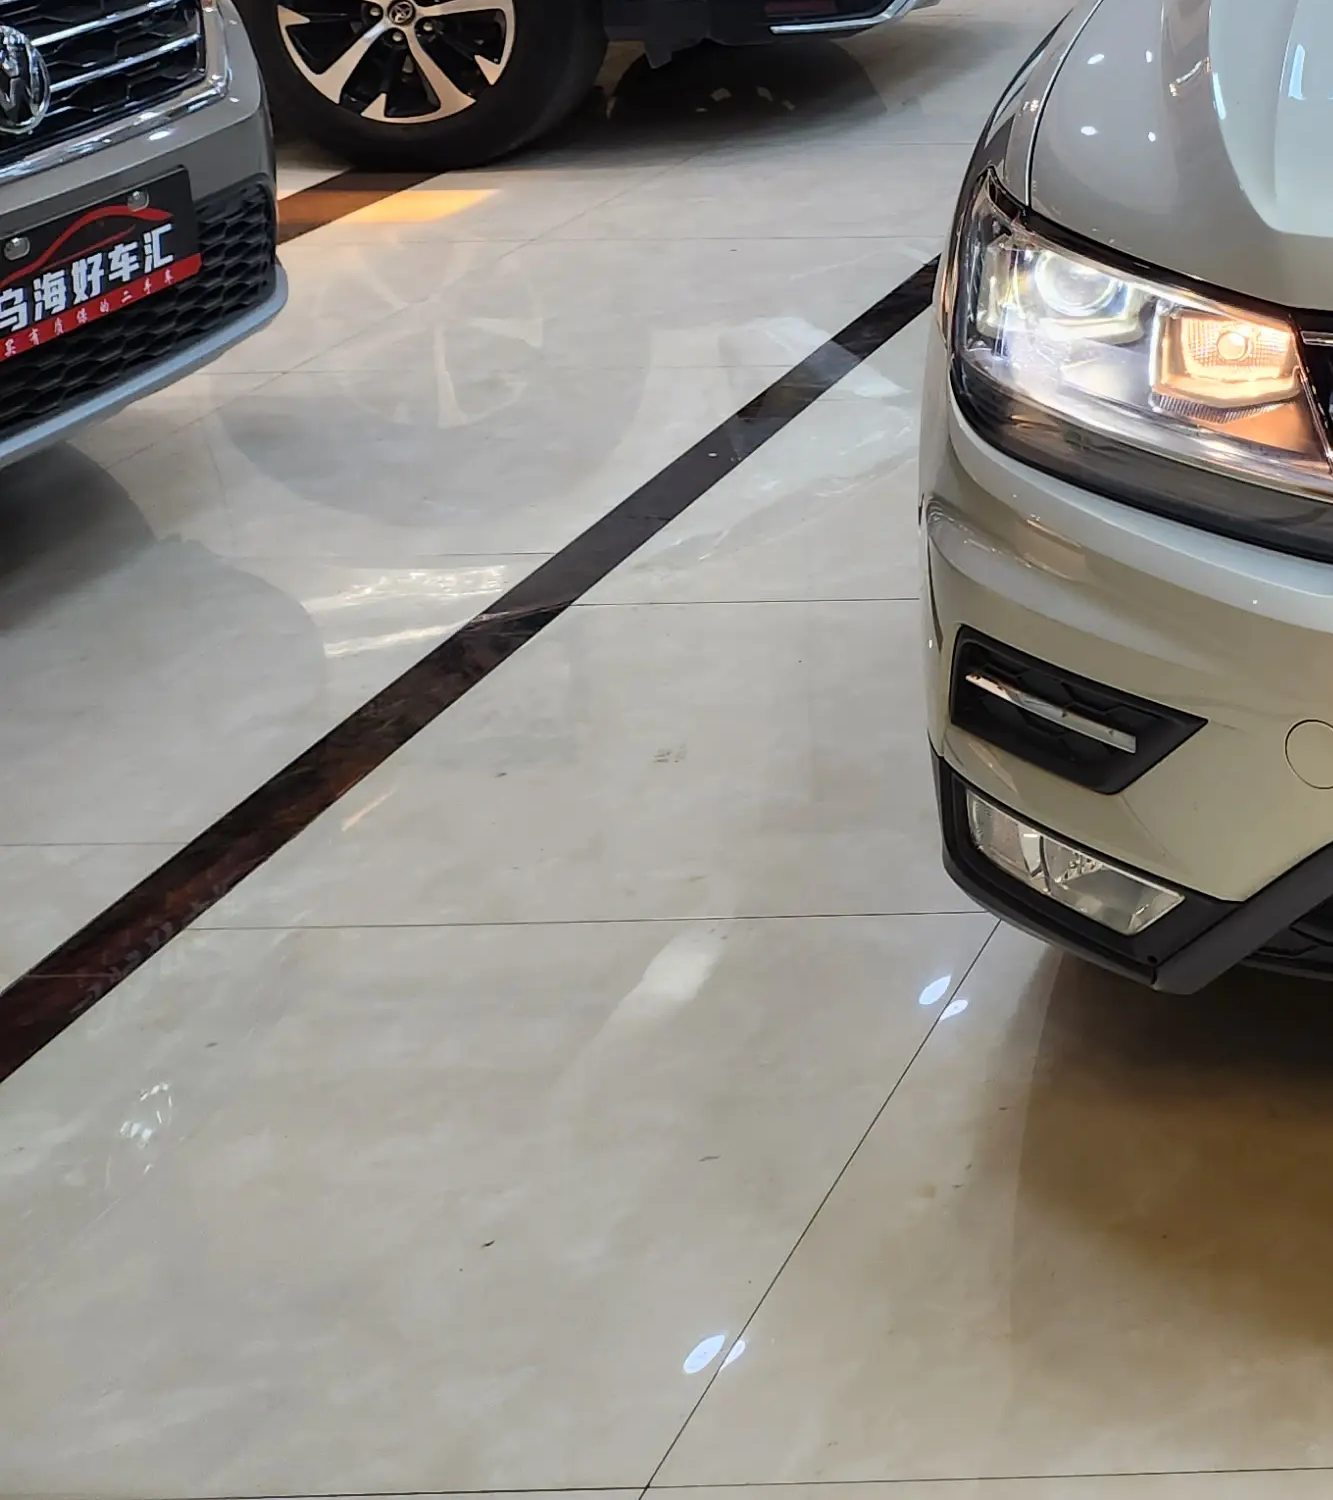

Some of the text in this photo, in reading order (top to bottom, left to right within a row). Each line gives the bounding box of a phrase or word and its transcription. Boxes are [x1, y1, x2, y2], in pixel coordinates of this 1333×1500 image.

[0, 223, 174, 332] 乌海好车汇
